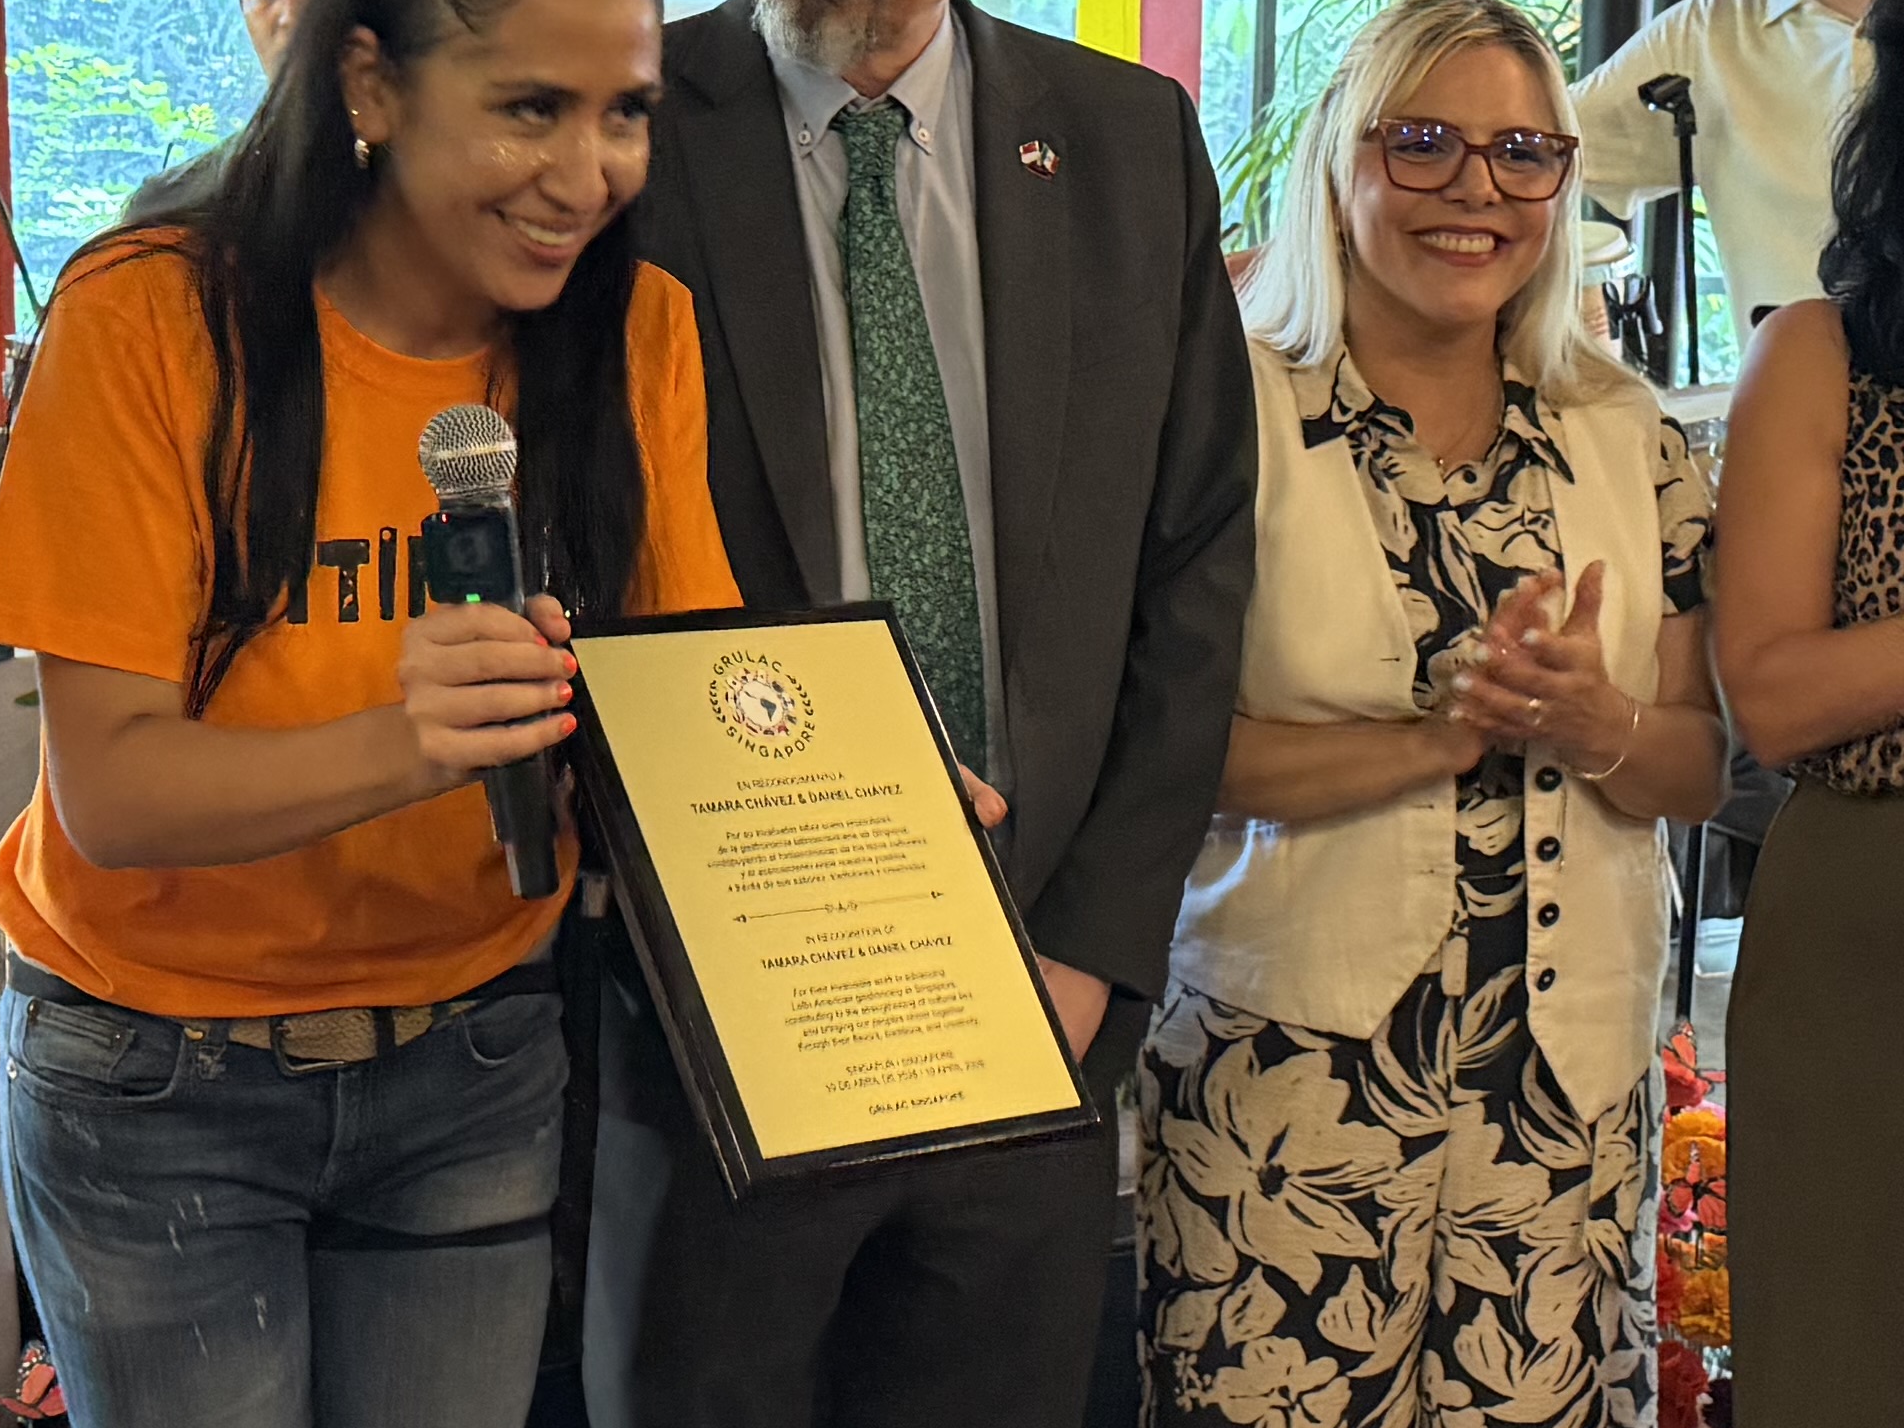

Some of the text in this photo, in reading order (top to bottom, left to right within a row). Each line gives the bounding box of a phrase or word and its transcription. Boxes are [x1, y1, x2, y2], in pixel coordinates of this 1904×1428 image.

[713, 649, 783, 676] GRULAC
[726, 721, 816, 760] SINGAPORE
[690, 799, 745, 814] TAMARA
[745, 793, 796, 810] CHÁVEZ
[797, 793, 807, 805] &
[808, 789, 853, 804] DANIEL
[761, 954, 809, 970] TAMARA
